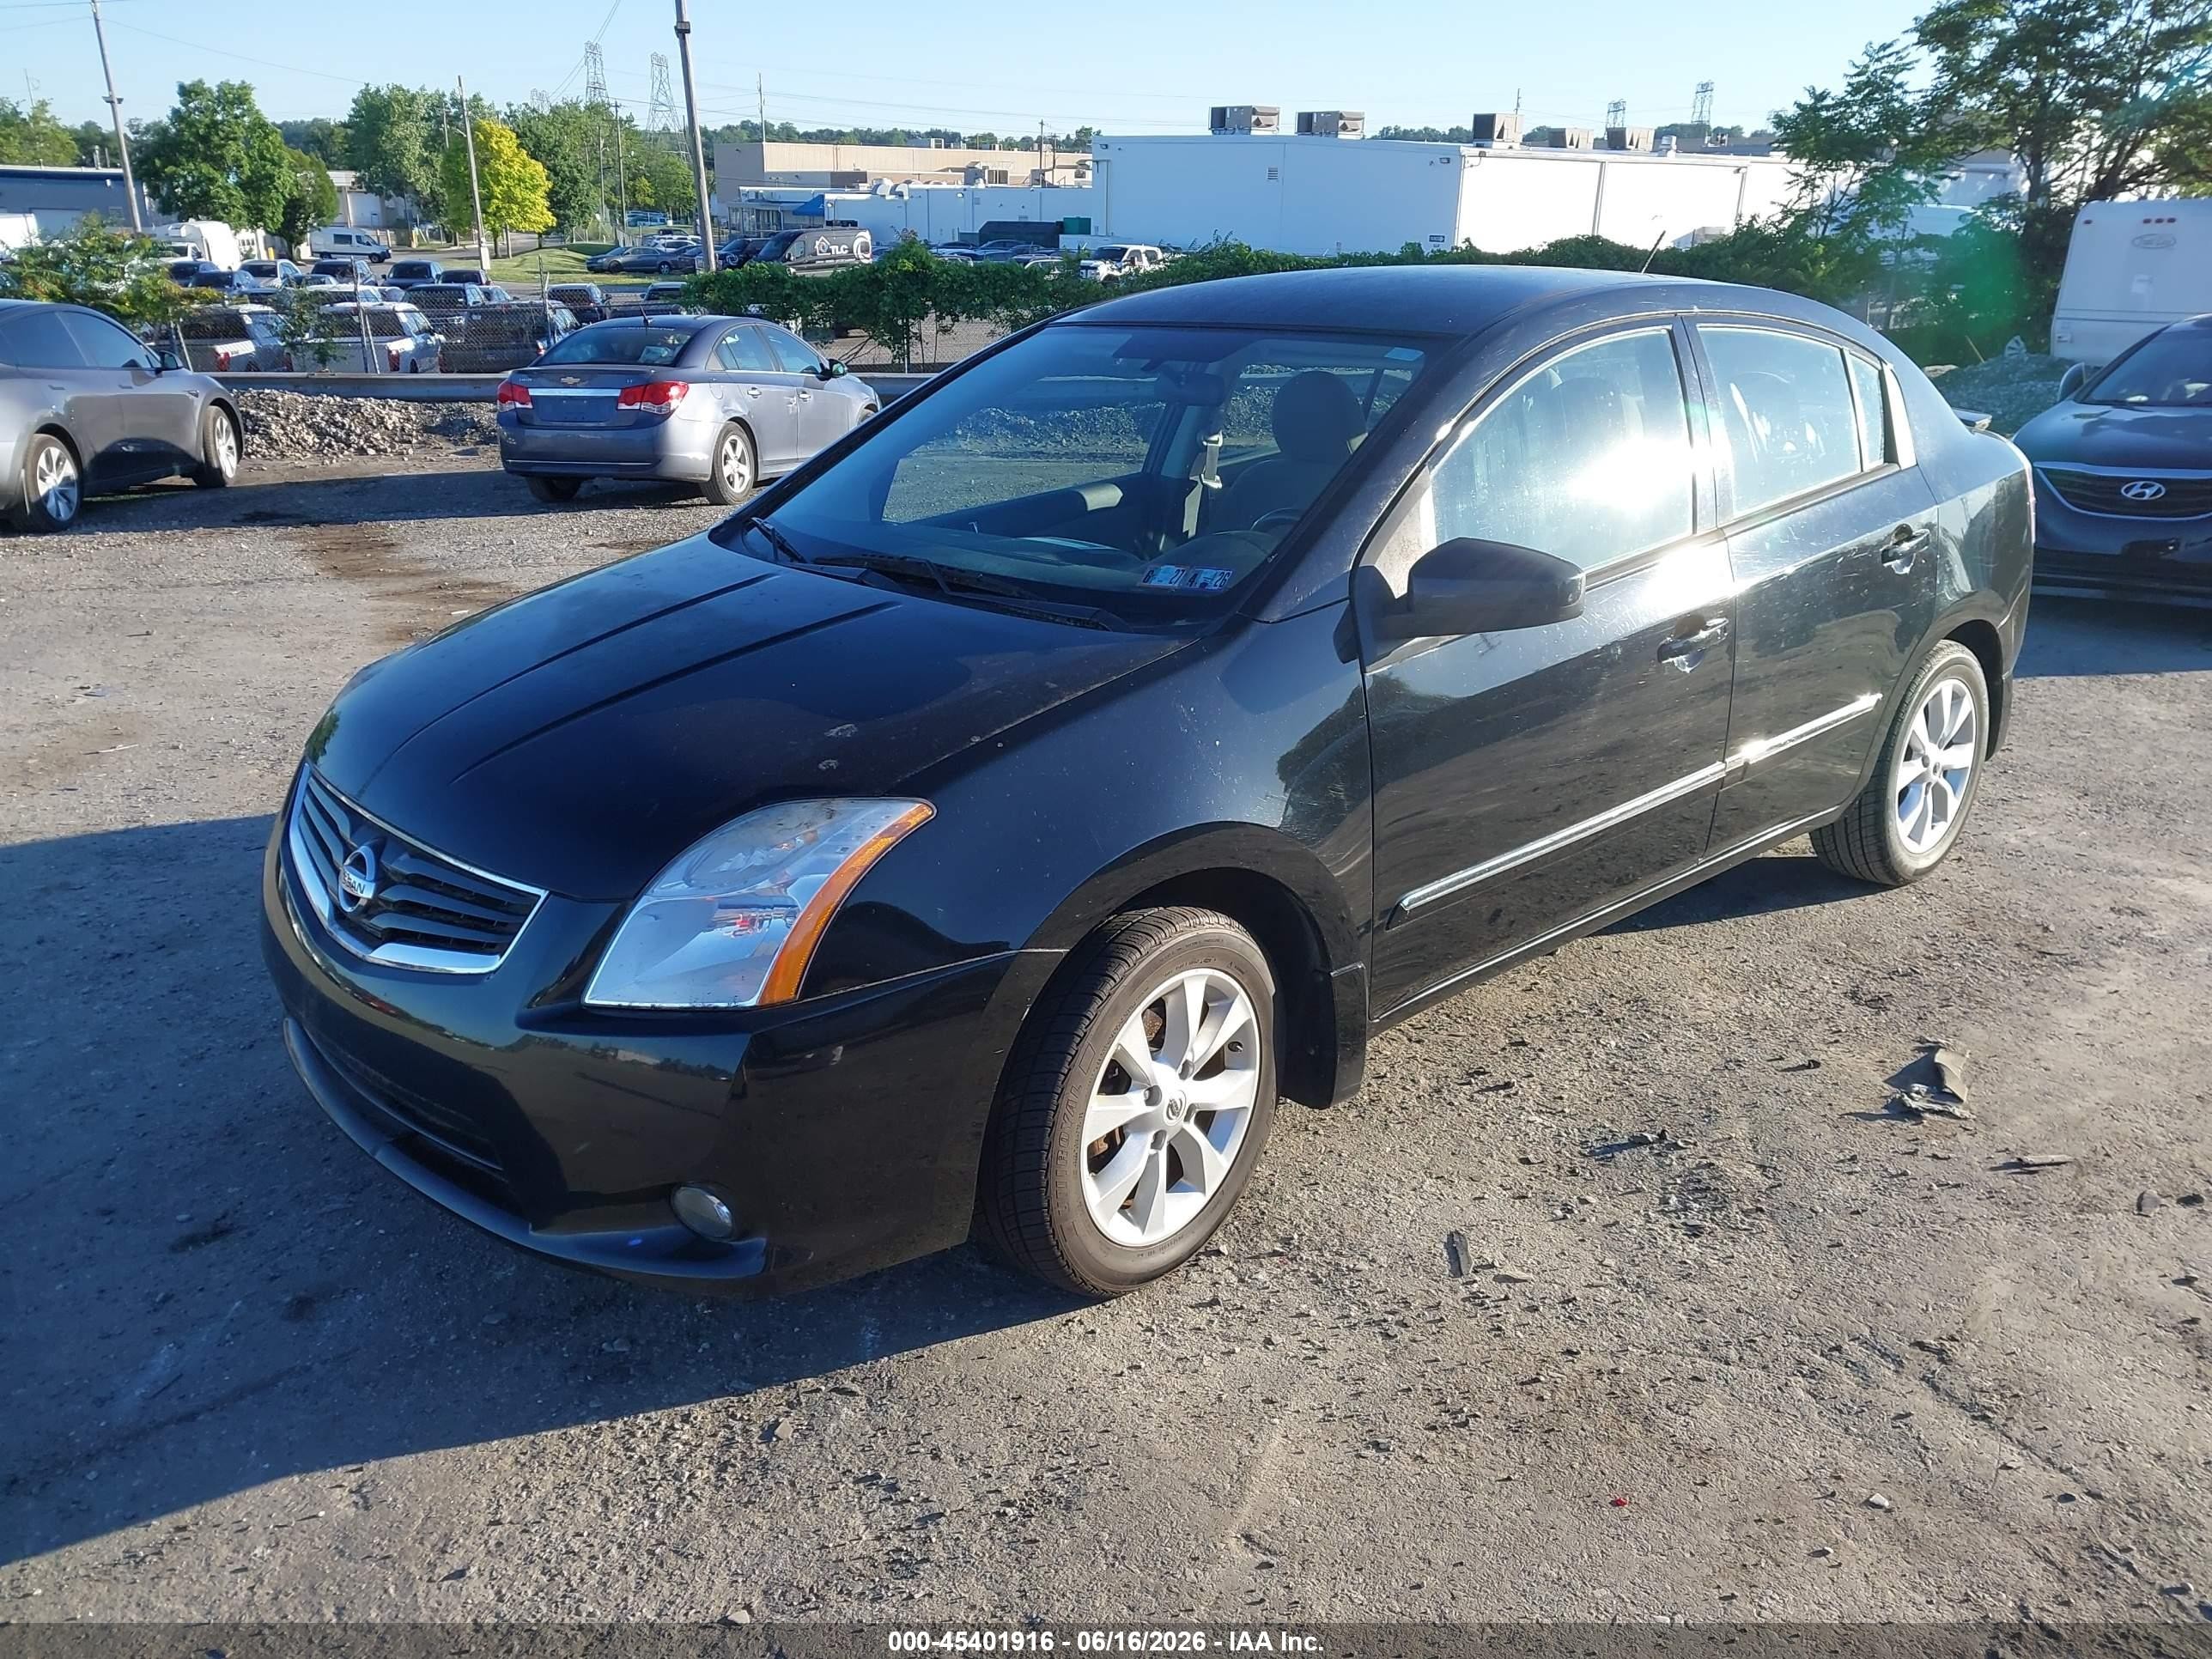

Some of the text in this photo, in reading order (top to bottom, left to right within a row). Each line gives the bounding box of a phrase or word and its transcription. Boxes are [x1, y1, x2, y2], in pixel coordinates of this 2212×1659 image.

[830, 245, 849, 255] TLC
[1168, 568, 1186, 585] 27
[1213, 571, 1231, 587] 26
